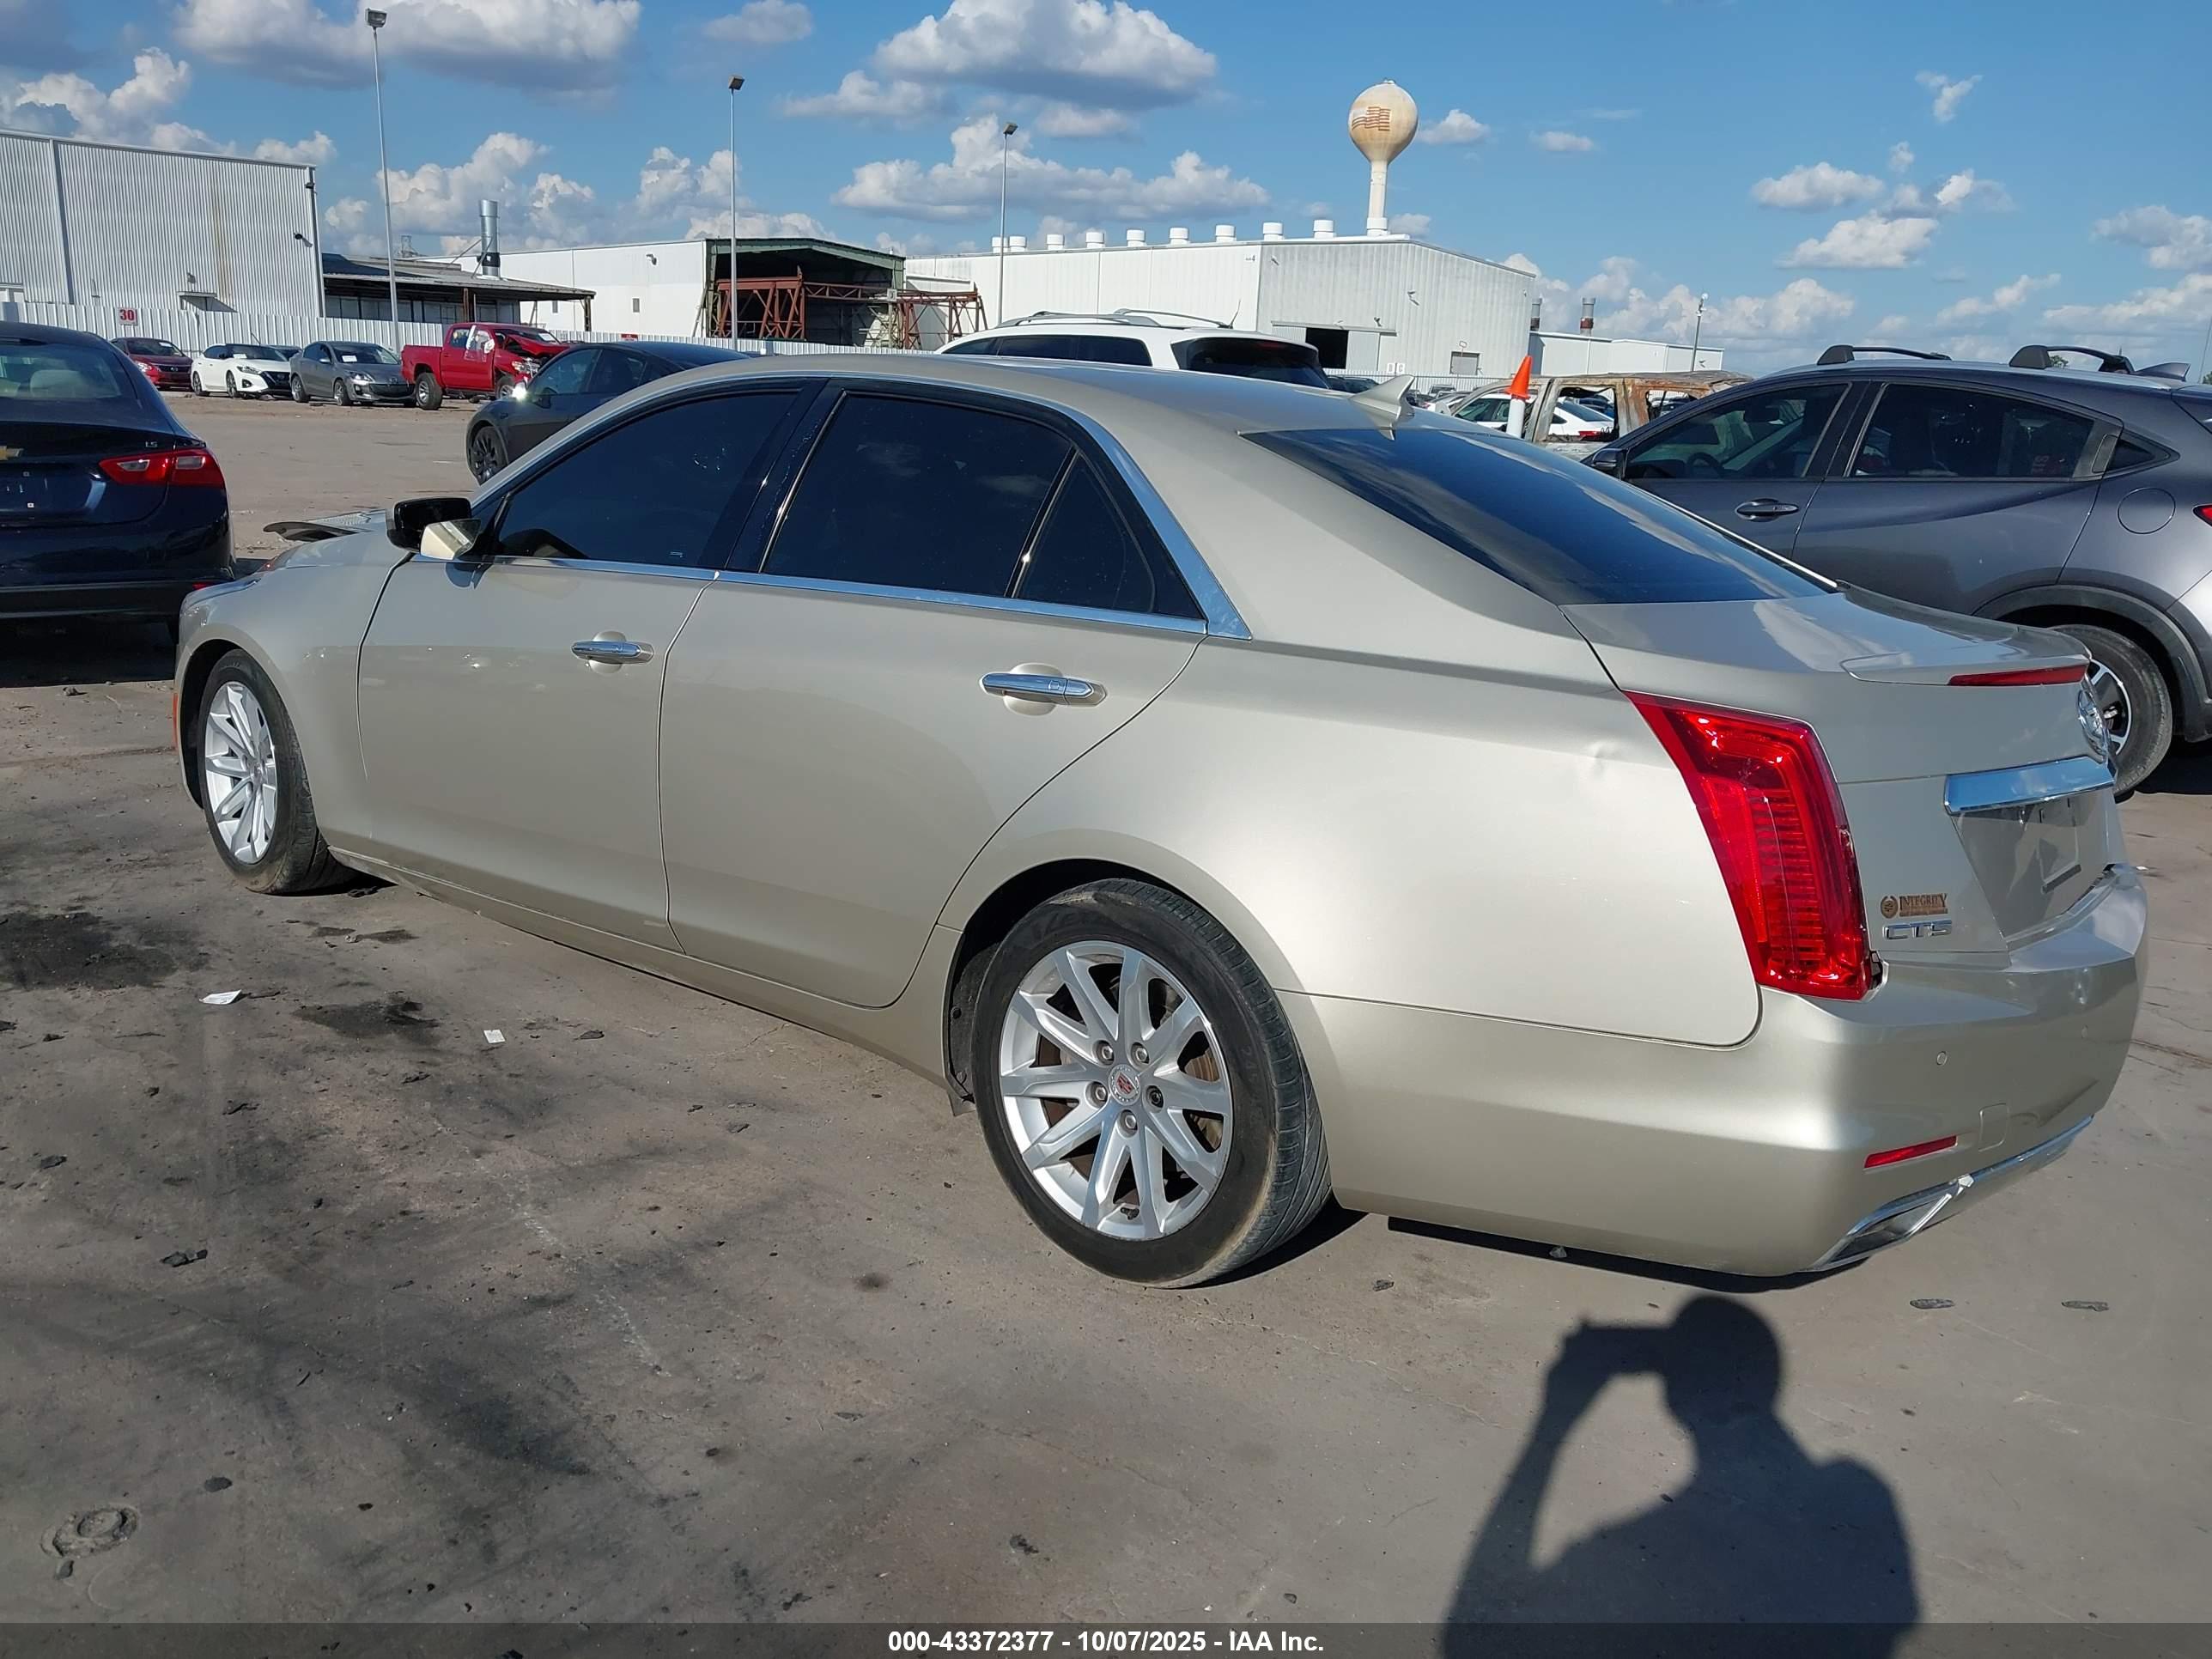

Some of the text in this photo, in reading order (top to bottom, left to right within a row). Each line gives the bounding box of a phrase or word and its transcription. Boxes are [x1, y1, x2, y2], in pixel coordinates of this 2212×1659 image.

[119, 308, 135, 321] 30
[1899, 893, 1948, 911] INTEGRITY
[1882, 920, 1952, 940] CTS
